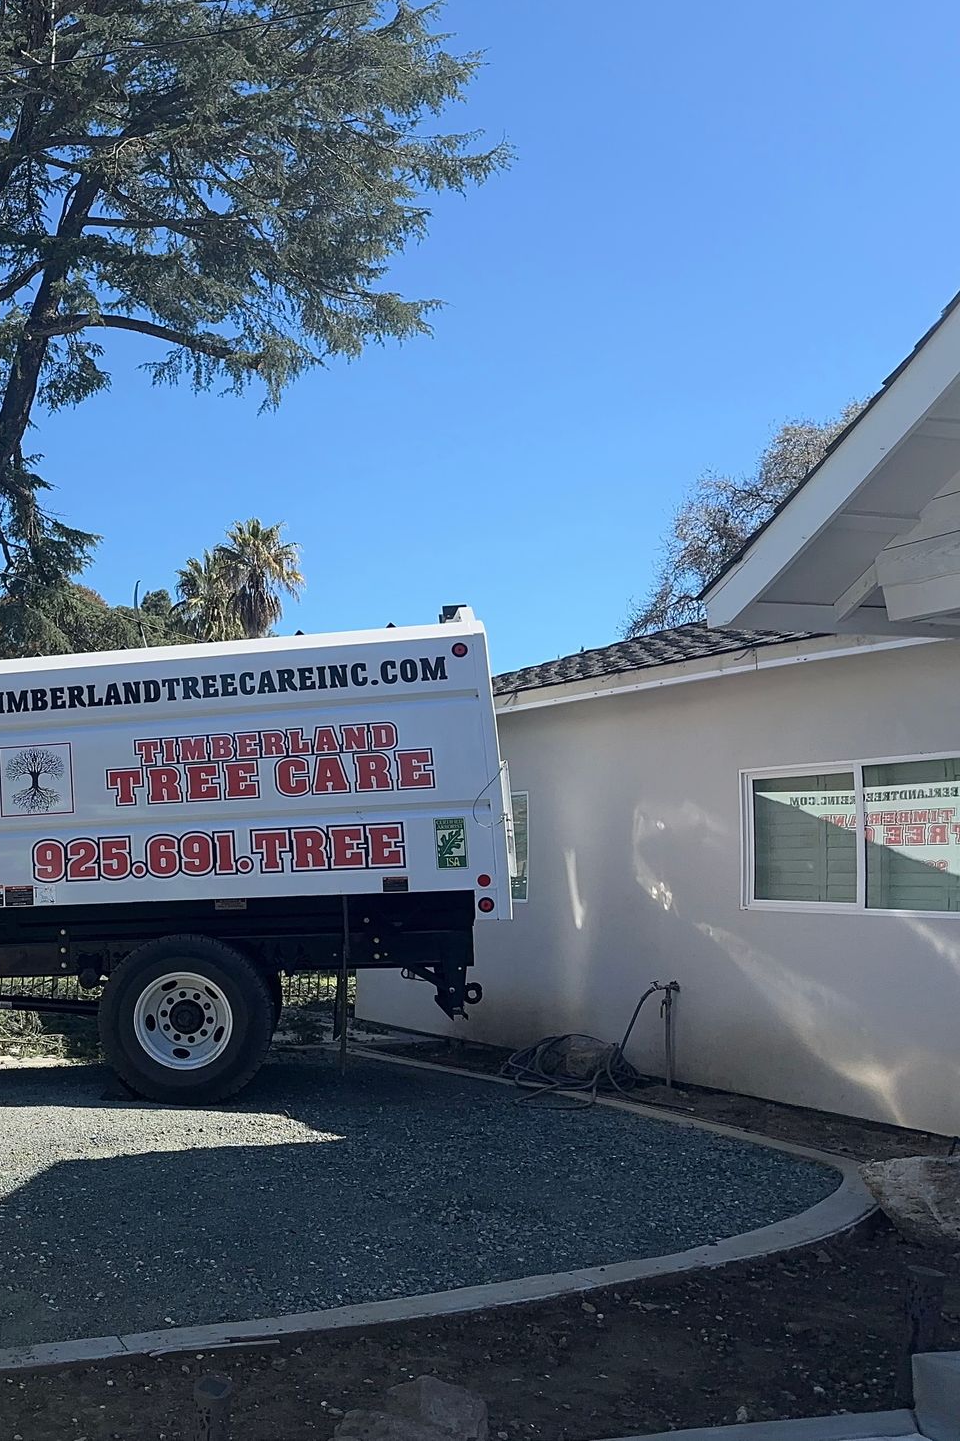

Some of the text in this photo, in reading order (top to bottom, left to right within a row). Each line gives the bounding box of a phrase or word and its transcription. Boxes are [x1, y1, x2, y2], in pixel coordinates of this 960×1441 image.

[134, 721, 398, 766] TIMBERLAND
[106, 747, 436, 807] TREE CARE
[33, 821, 407, 883] 925.691.TREE
[446, 857, 461, 867] ISA
